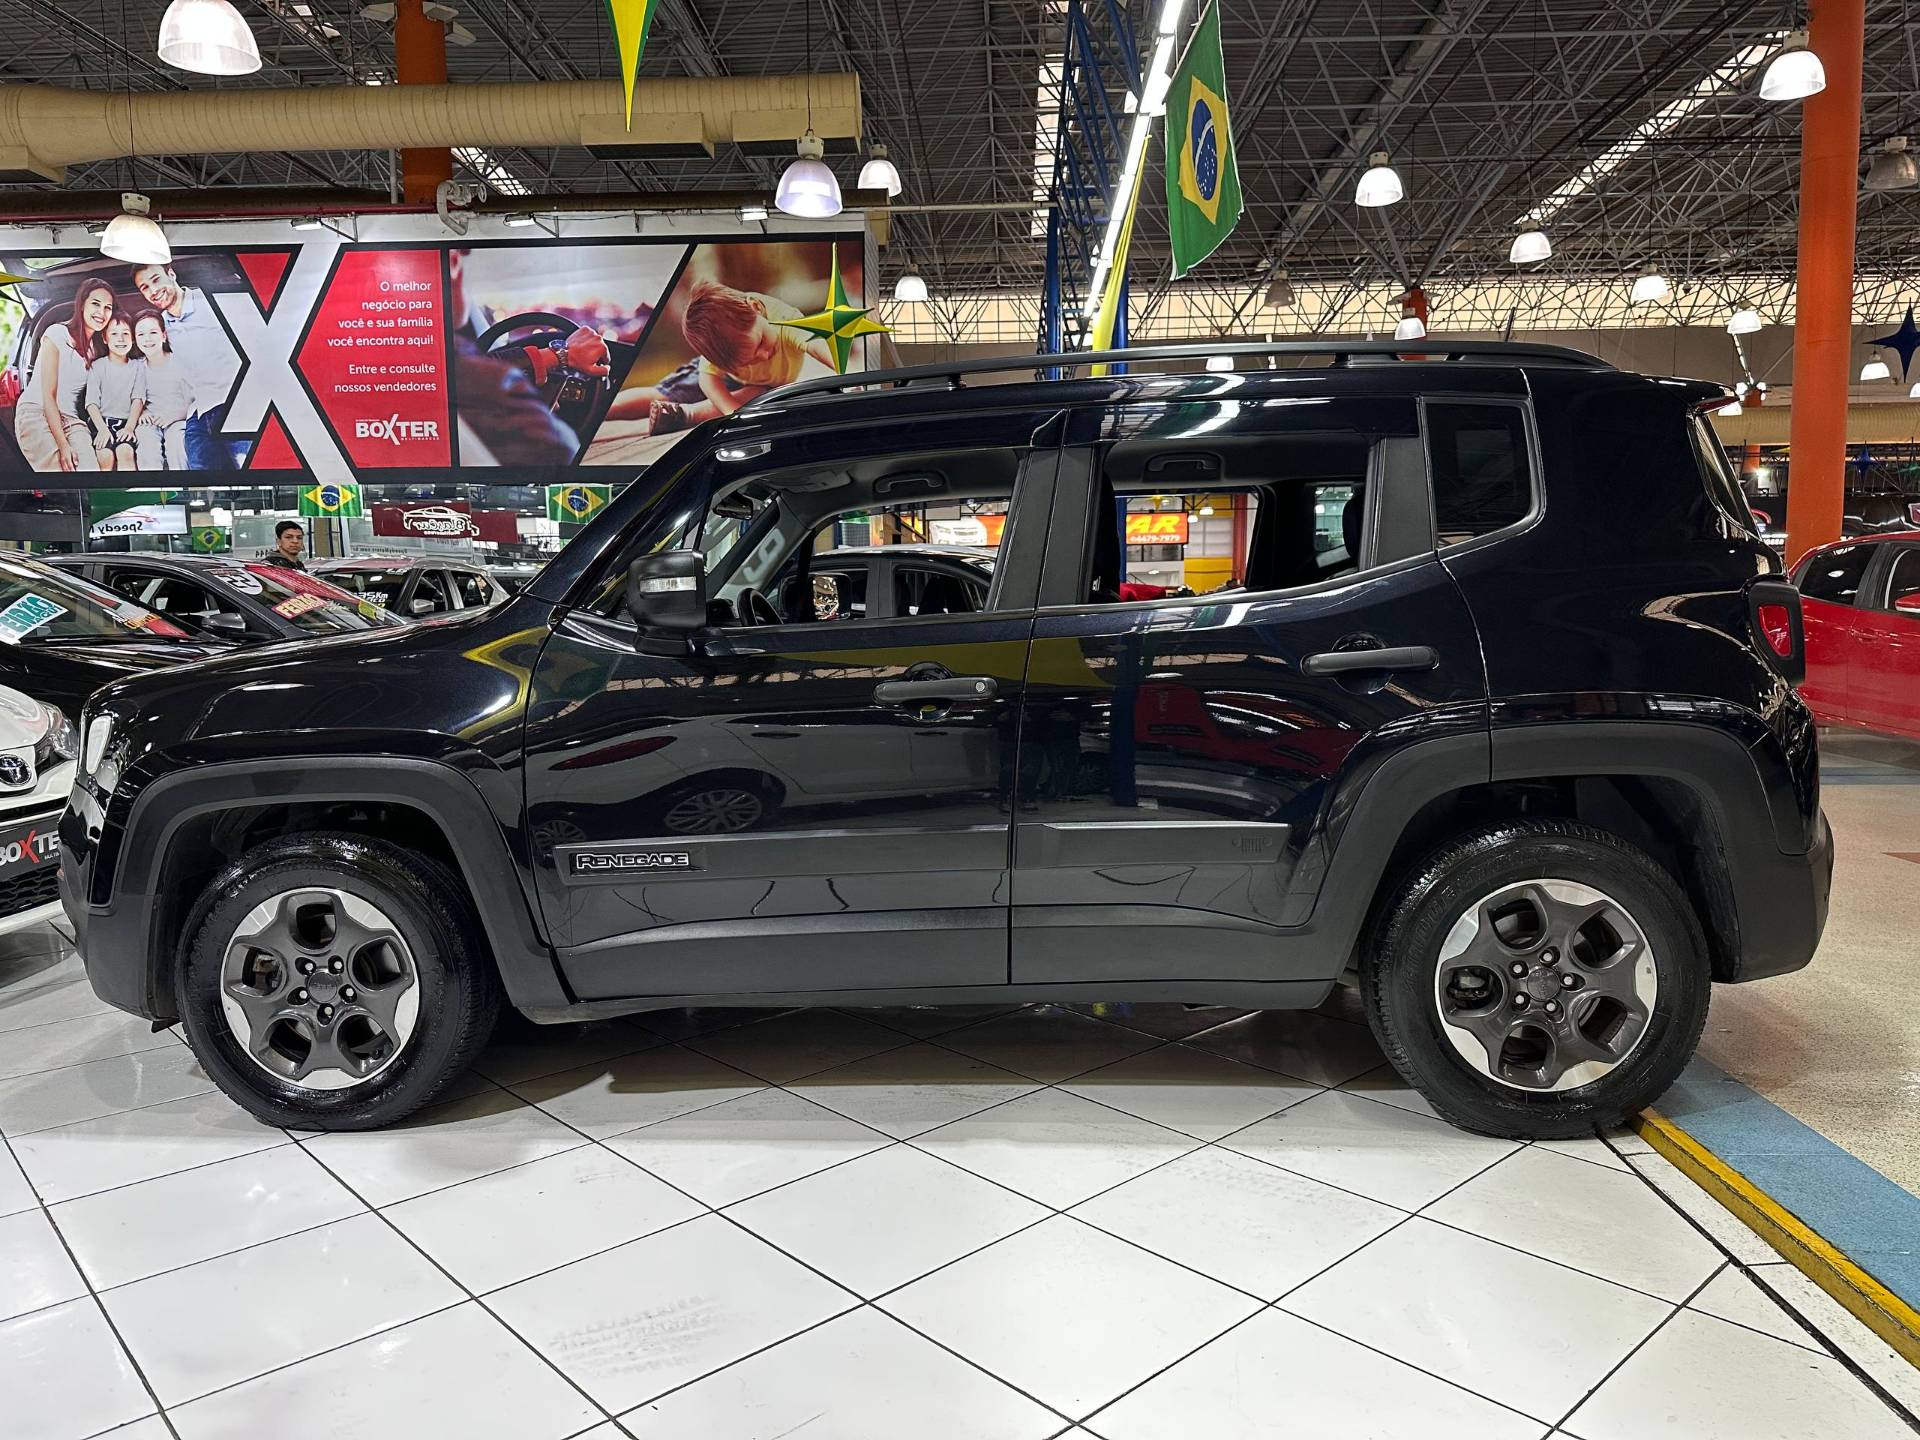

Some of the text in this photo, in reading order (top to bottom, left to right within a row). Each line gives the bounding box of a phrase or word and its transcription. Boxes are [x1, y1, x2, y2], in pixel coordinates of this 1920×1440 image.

[380, 281, 432, 292] O melhor
[362, 299, 432, 312] negócio para
[338, 318, 364, 328] você
[397, 316, 433, 327] família
[328, 336, 434, 347] você encontra aqui!
[349, 364, 377, 375] Entre
[390, 364, 436, 374] consulte
[334, 382, 436, 392] nossos vendedores
[356, 414, 439, 445] BOXTER
[1126, 515, 1180, 534] AR
[0, 830, 60, 866] OXTE
[576, 853, 688, 869] RENEGADE
